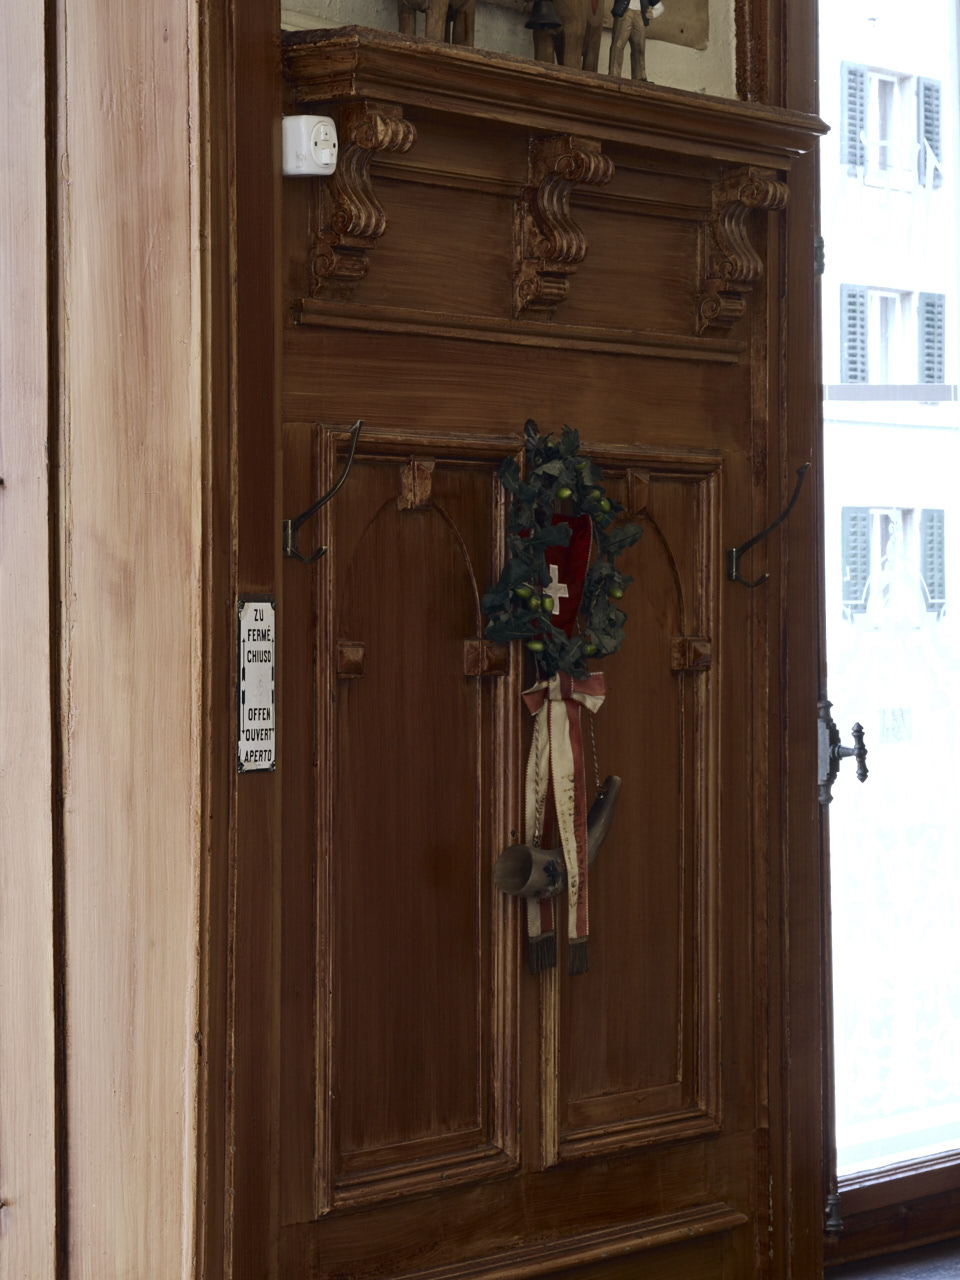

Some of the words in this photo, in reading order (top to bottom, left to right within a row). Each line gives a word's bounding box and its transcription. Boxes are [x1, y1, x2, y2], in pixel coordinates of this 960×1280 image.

[253, 608, 264, 622] ZU
[247, 624, 271, 642] FERMÉ
[246, 650, 272, 663] CHIUSO
[247, 707, 271, 721] OFFEN
[245, 727, 273, 742] OUVERT
[243, 749, 272, 763] APERTO
